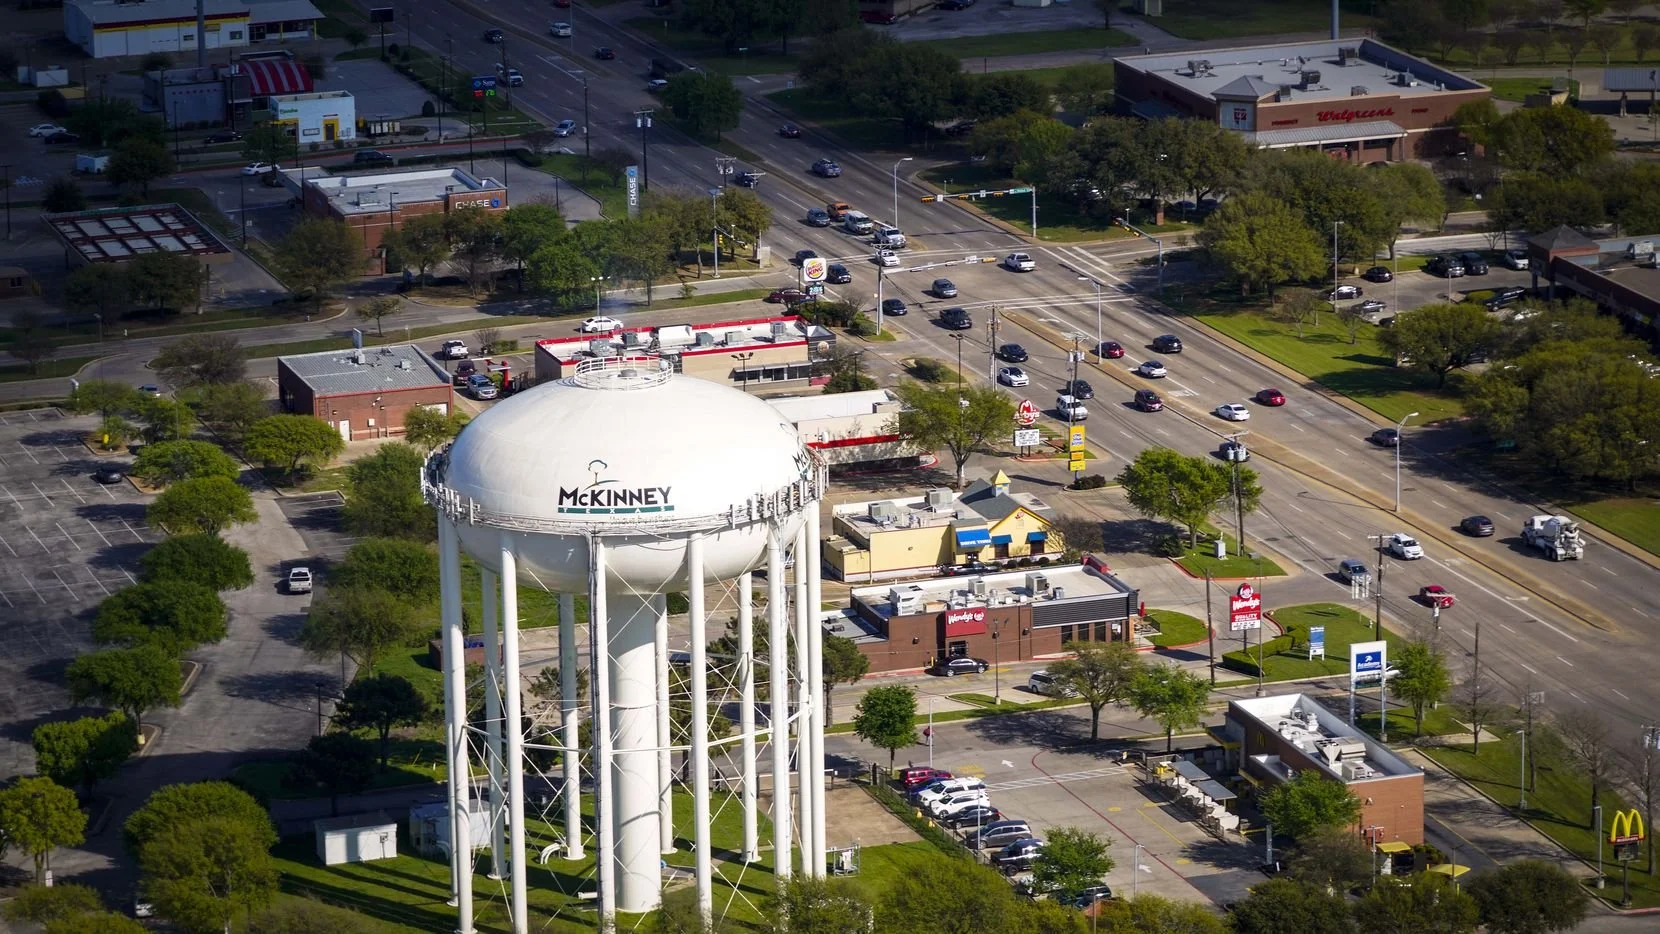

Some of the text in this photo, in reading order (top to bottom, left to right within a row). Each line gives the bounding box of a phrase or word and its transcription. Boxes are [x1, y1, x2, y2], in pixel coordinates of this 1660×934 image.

[1317, 107, 1395, 122] Walgreens
[455, 199, 490, 209] CHASE
[558, 486, 672, 507] McKINNEY
[563, 506, 666, 514] TEXAS
[1232, 597, 1260, 611] Wendy's
[948, 611, 974, 624] Wendy's
